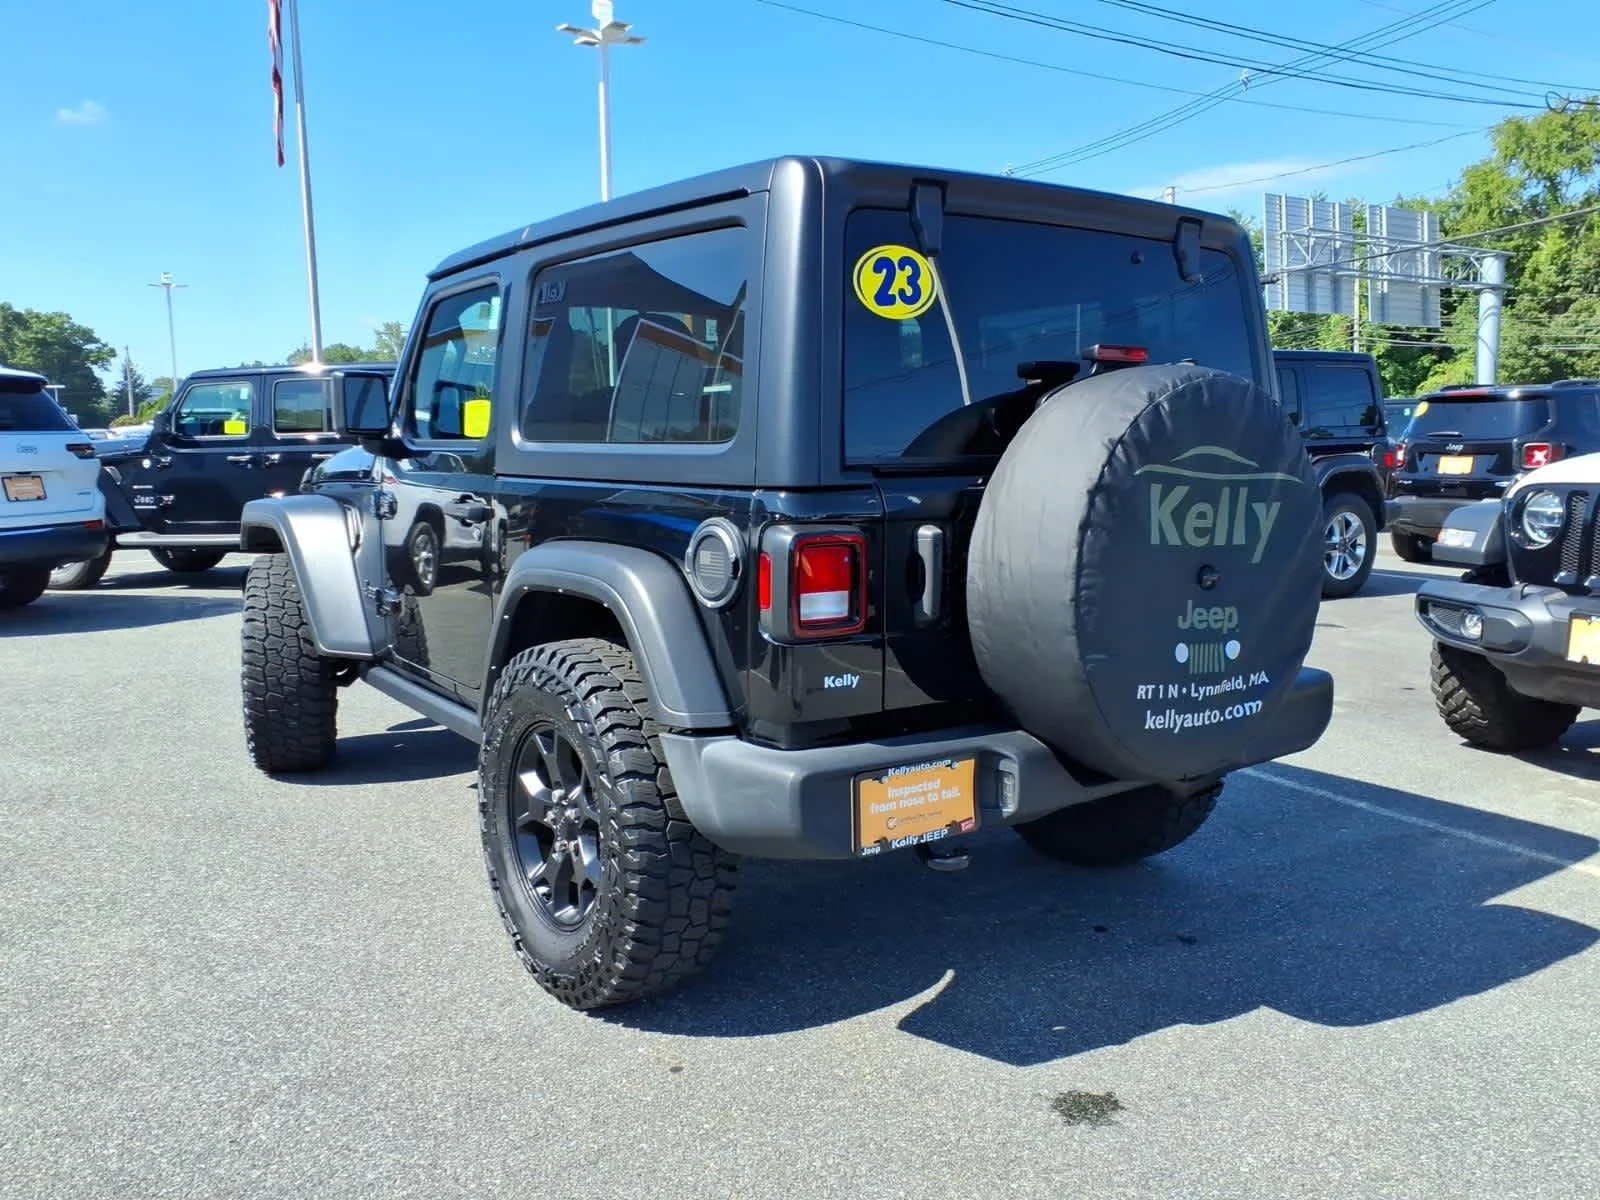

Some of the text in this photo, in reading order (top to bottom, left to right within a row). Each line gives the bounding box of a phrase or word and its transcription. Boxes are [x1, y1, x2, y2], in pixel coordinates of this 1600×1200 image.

[873, 255, 922, 307] 23
[1149, 482, 1281, 564] Kelly
[1177, 599, 1239, 634] Jeep
[823, 673, 861, 689] Kelly
[1136, 684, 1155, 700] RT
[1159, 684, 1164, 699] 1
[1168, 683, 1179, 699] N
[1248, 669, 1270, 687] MA
[1144, 699, 1263, 734] kellyauto.com
[887, 759, 952, 777] Kellyauto.com
[870, 801, 897, 814] from
[928, 791, 939, 802] to
[861, 845, 881, 856] Jeep
[891, 828, 949, 849] Kelly JEEP
